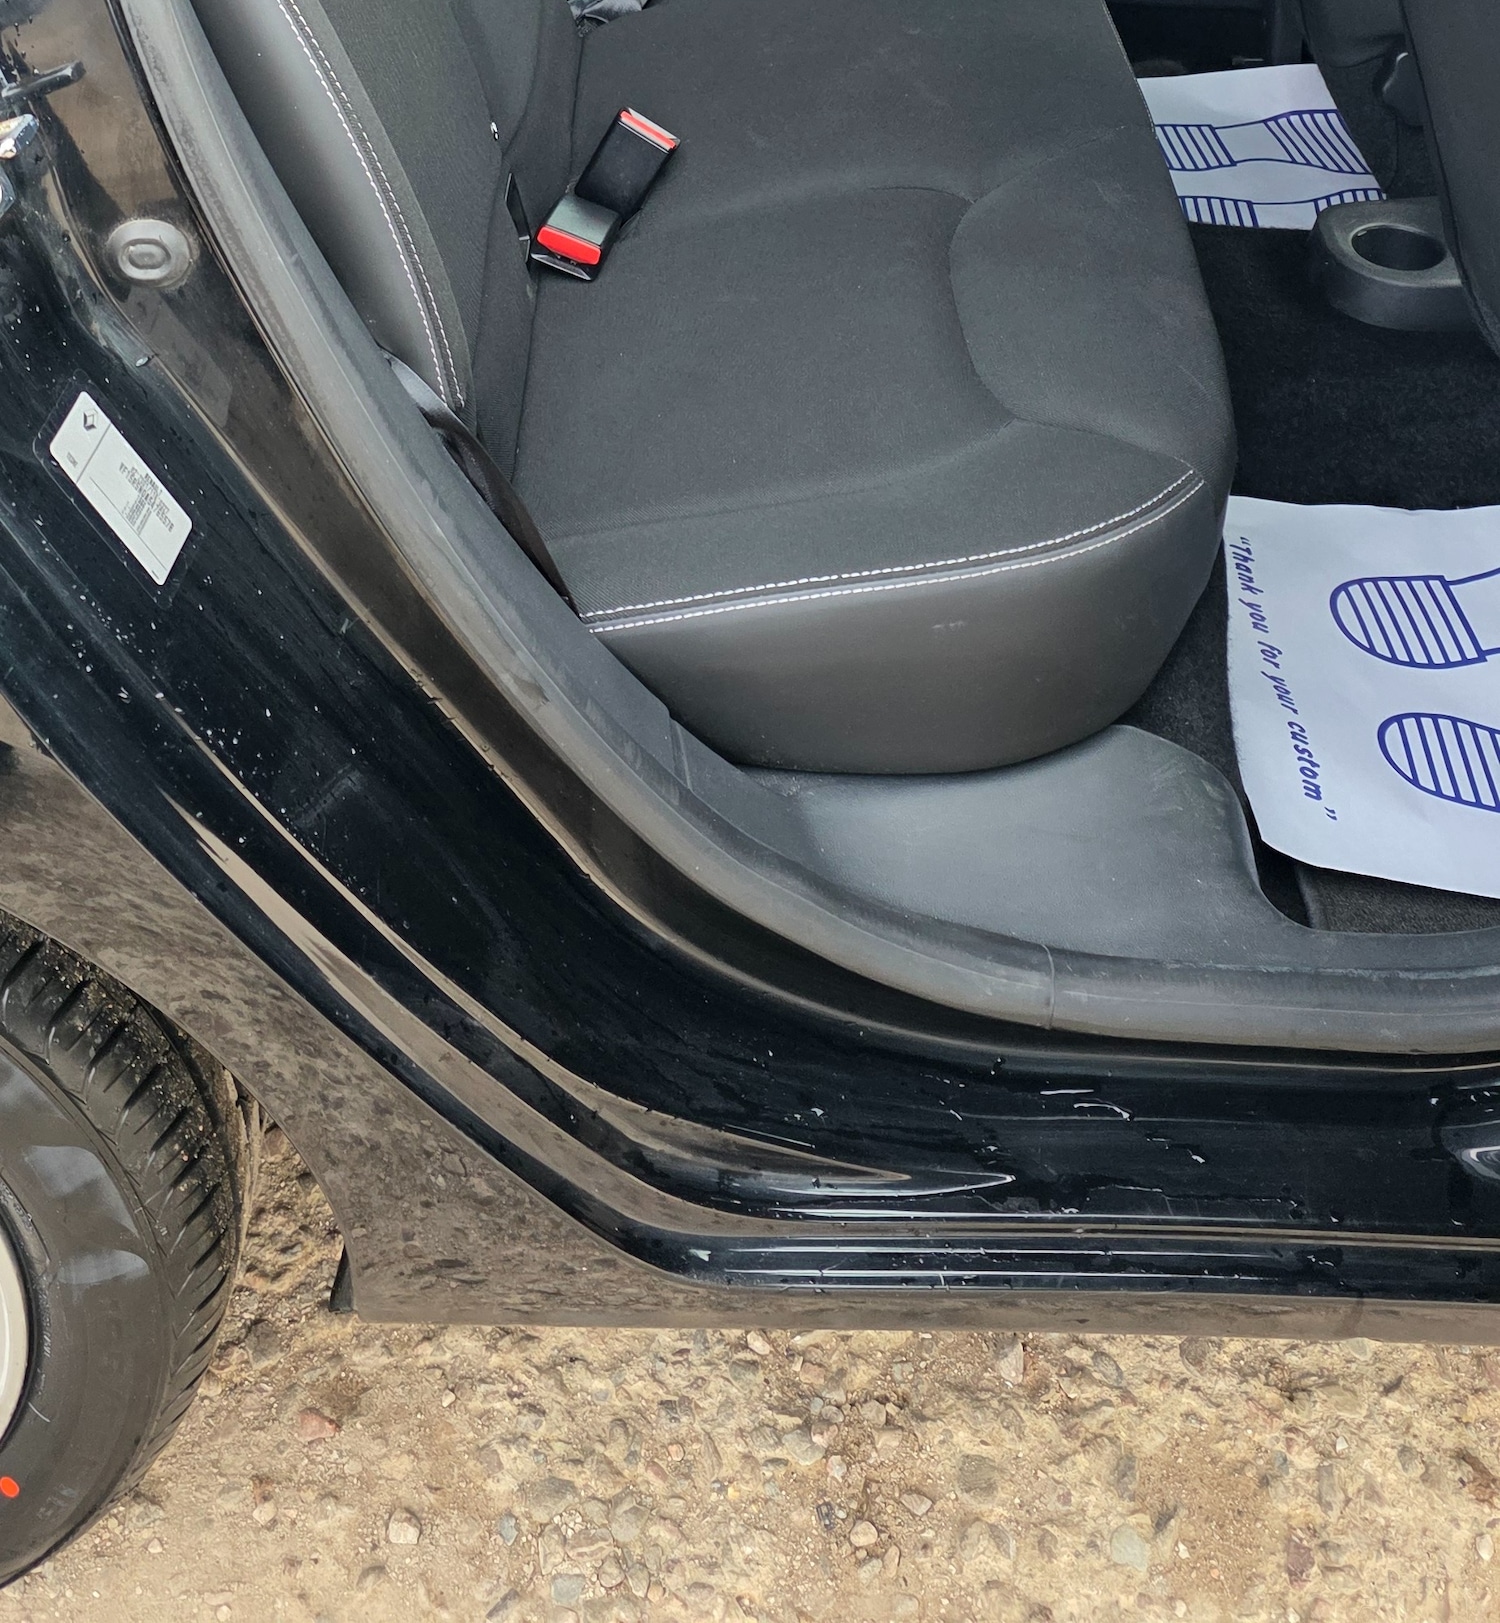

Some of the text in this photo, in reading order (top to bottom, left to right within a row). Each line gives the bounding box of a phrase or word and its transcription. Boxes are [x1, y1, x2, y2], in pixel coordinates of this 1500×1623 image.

[1238, 596, 1270, 634] you
[1257, 640, 1283, 670] for
[1260, 670, 1299, 716] your
